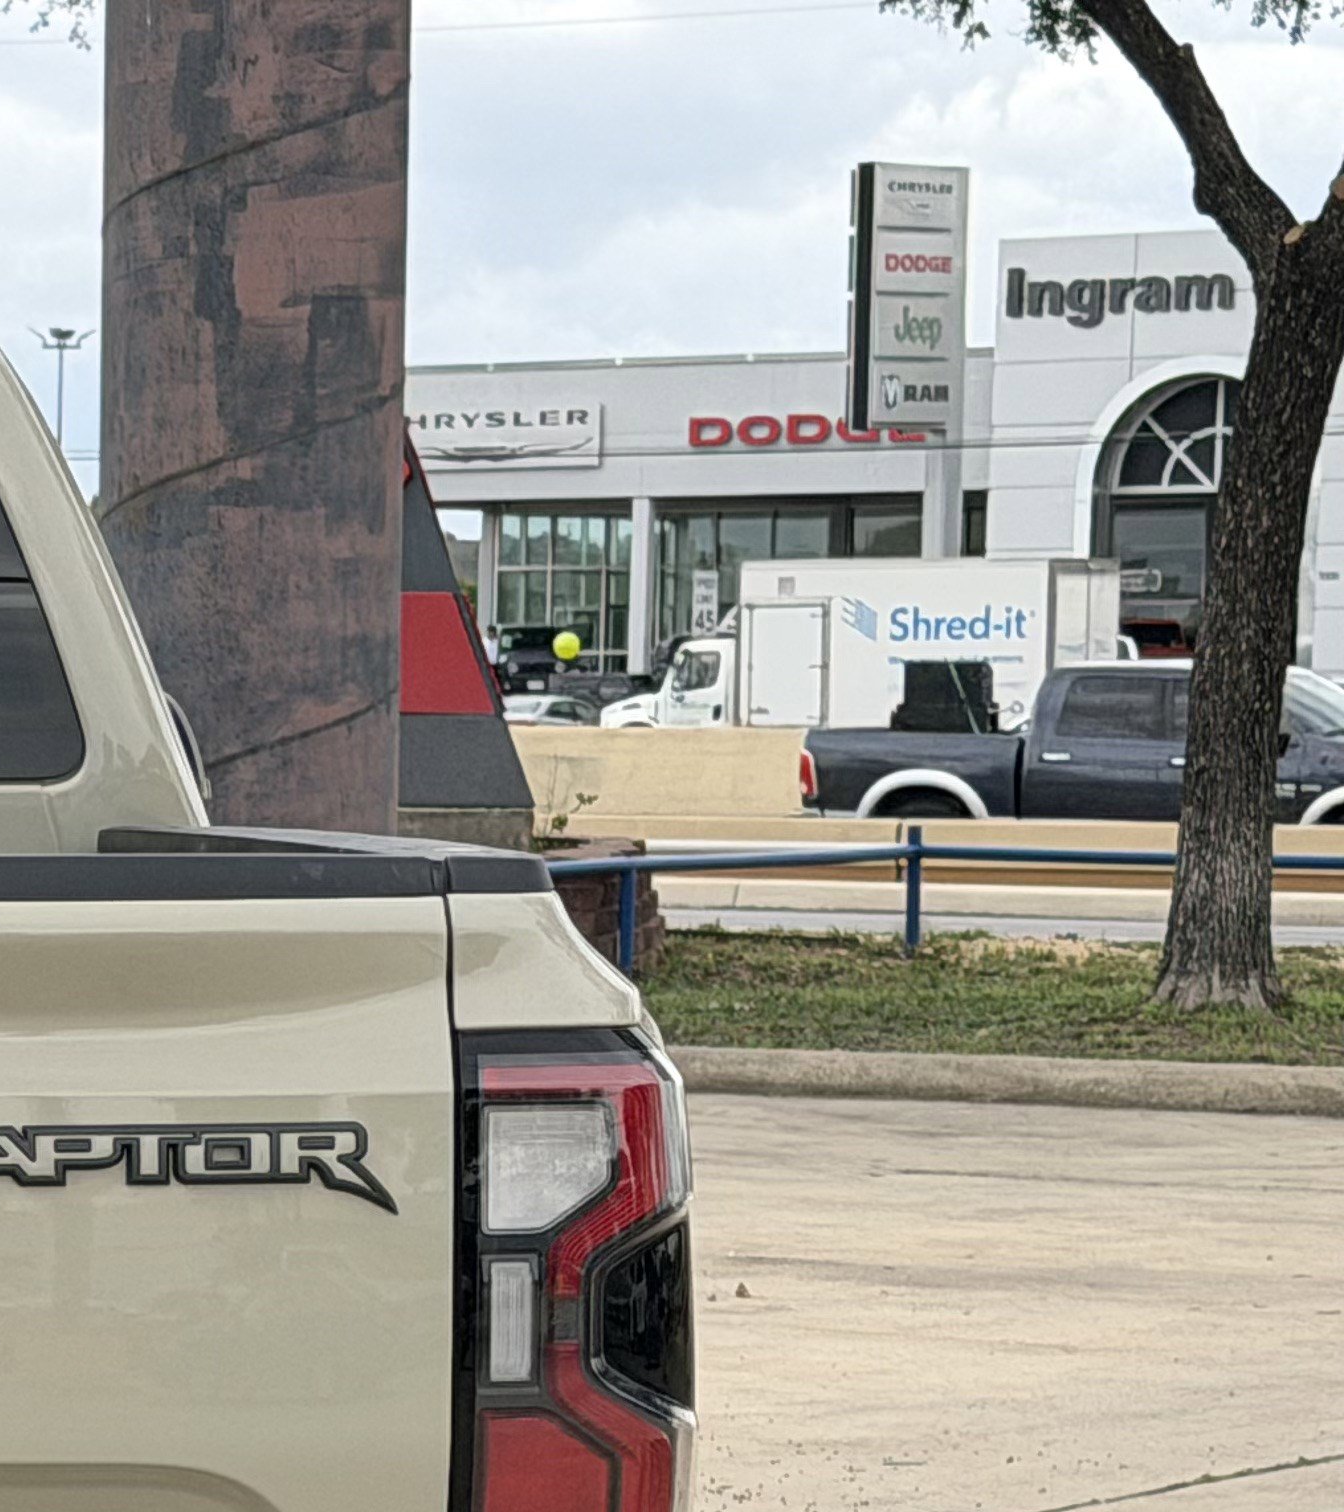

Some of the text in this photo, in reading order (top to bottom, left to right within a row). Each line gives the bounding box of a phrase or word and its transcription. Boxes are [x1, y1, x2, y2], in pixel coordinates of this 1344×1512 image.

[885, 253, 953, 275] DODGE
[1006, 267, 1236, 329] Ingram
[894, 305, 942, 351] Jeep
[903, 384, 949, 403] RAM
[404, 409, 589, 430] HRYSLER
[694, 609, 714, 633] 45
[889, 604, 1027, 642] Shred-it
